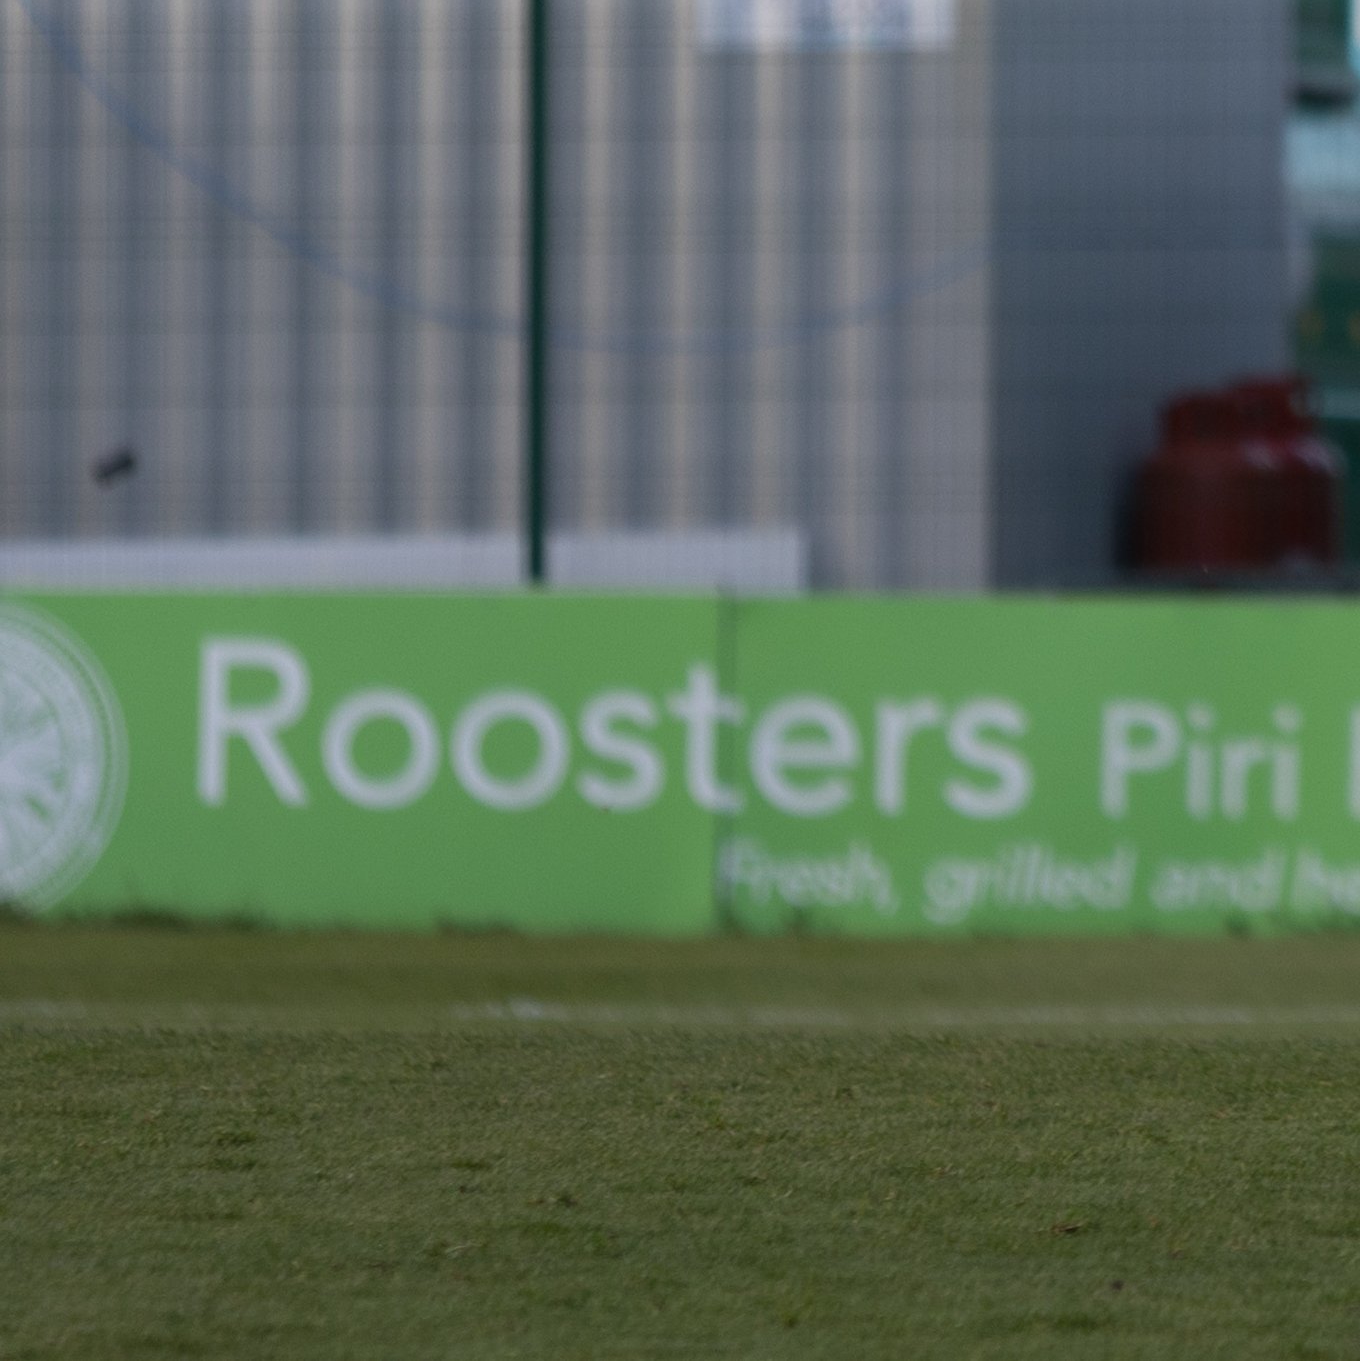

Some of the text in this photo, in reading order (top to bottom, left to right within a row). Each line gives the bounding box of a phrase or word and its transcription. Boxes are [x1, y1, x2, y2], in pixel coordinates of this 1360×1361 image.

[197, 637, 1036, 819] Roosters
[1101, 698, 1300, 821] Piri
[921, 842, 1137, 926] grilled
[1150, 846, 1285, 911] and
